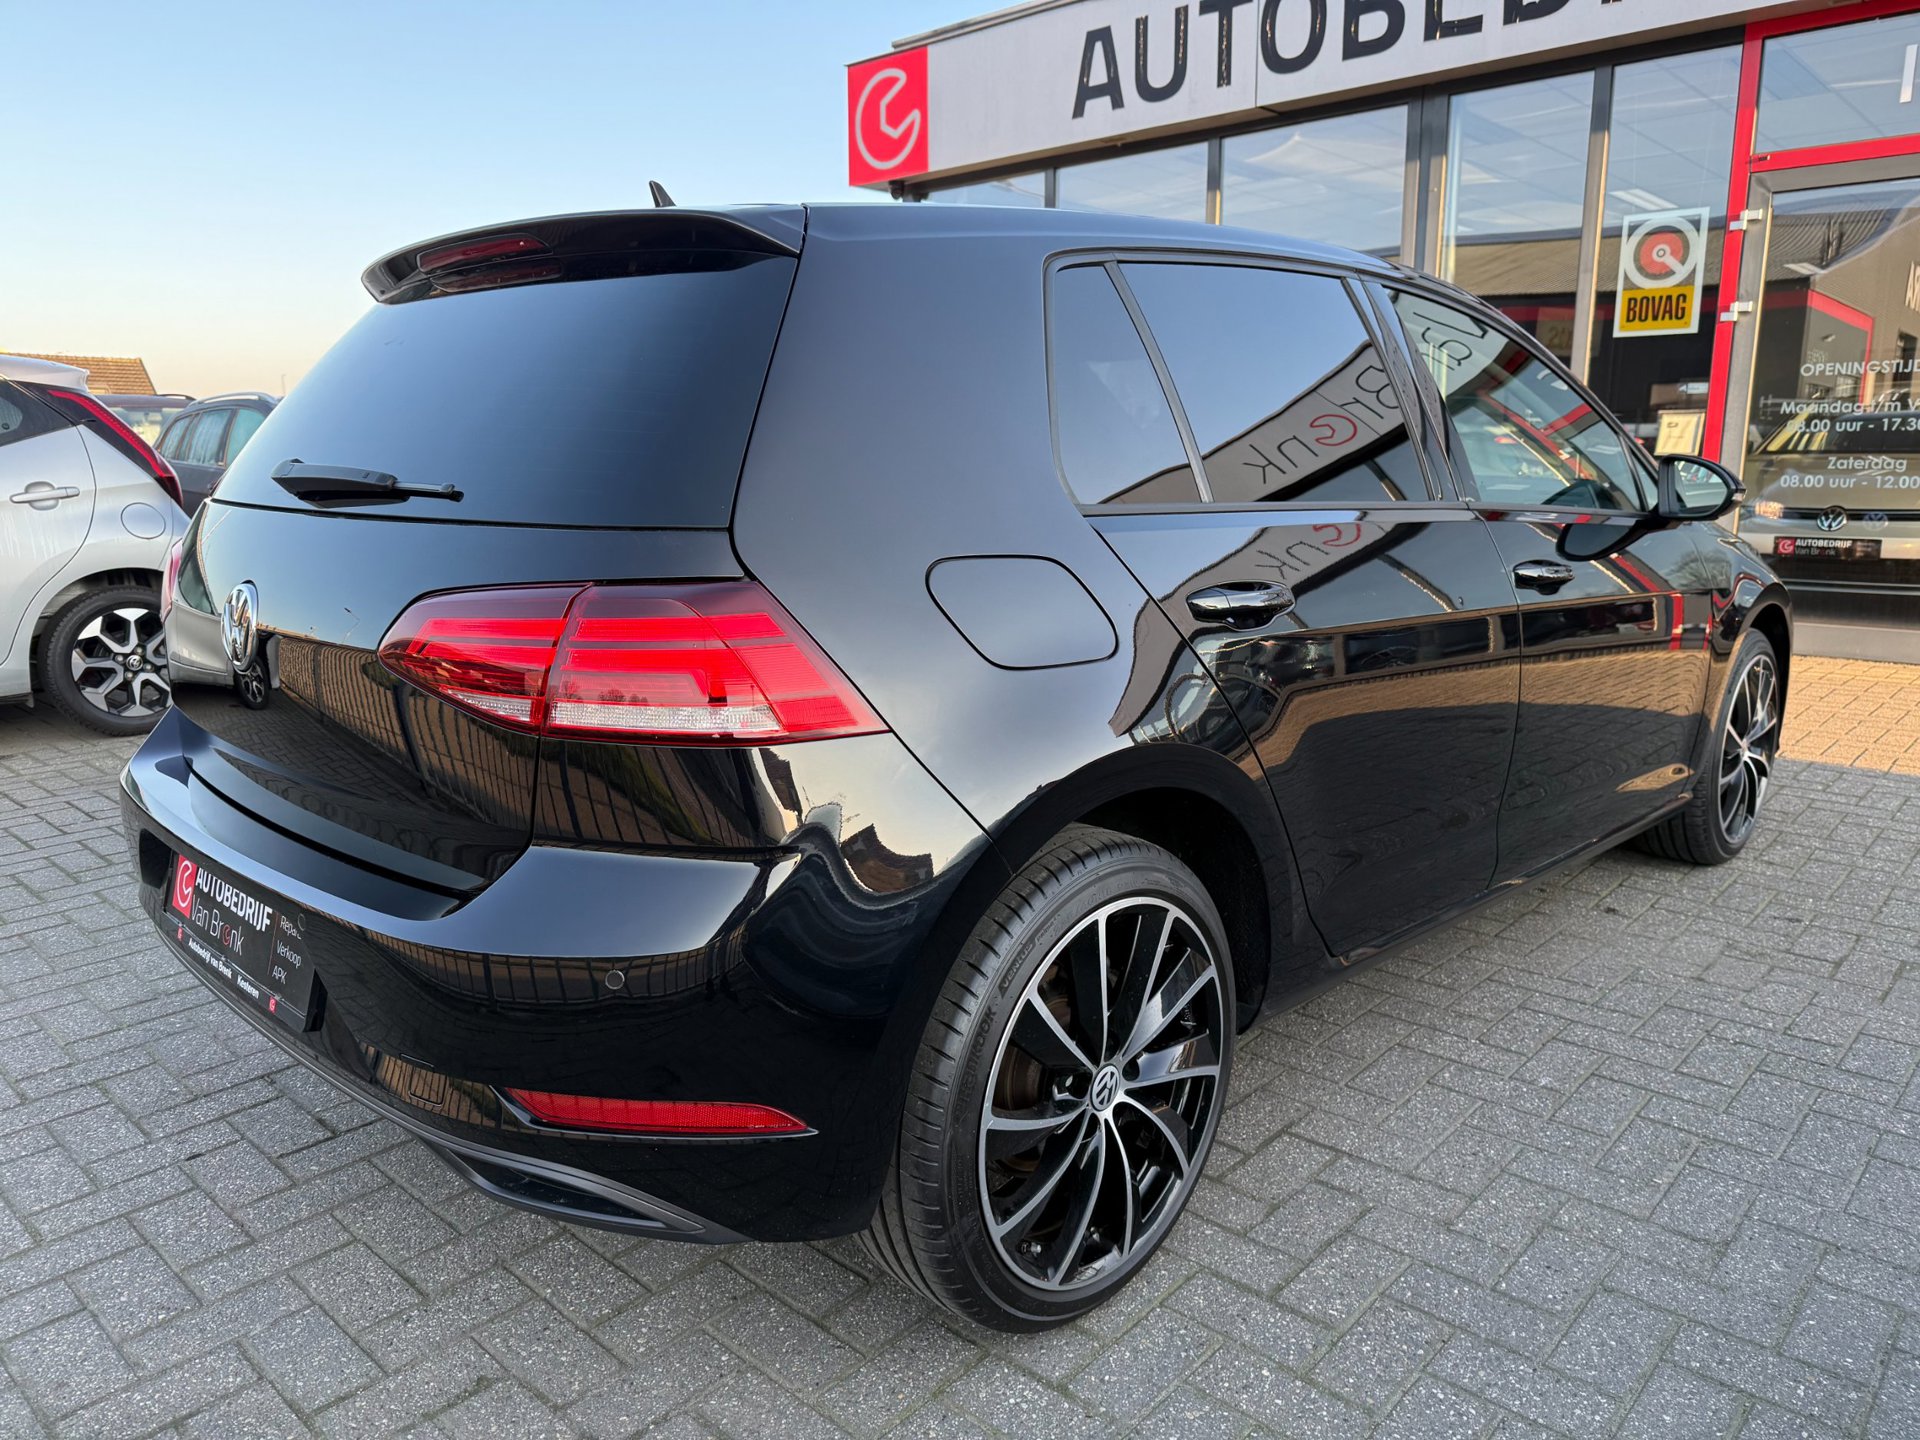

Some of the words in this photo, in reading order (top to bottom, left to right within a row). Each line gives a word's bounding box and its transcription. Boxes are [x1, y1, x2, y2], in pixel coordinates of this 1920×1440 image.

[1626, 294, 1687, 323] BOVAG
[1780, 401, 1864, 415] Maandag
[1835, 421, 1863, 431] uur
[1827, 456, 1908, 472] Zaterdag
[1780, 475, 1824, 488] 08.00
[1829, 477, 1856, 488] uur
[1795, 538, 1853, 549] AUTOBEDRIJF
[195, 867, 273, 932] AUTOBEDRIJF
[191, 894, 209, 931] Van
[276, 940, 302, 969] Verkoop
[271, 965, 287, 985] APK
